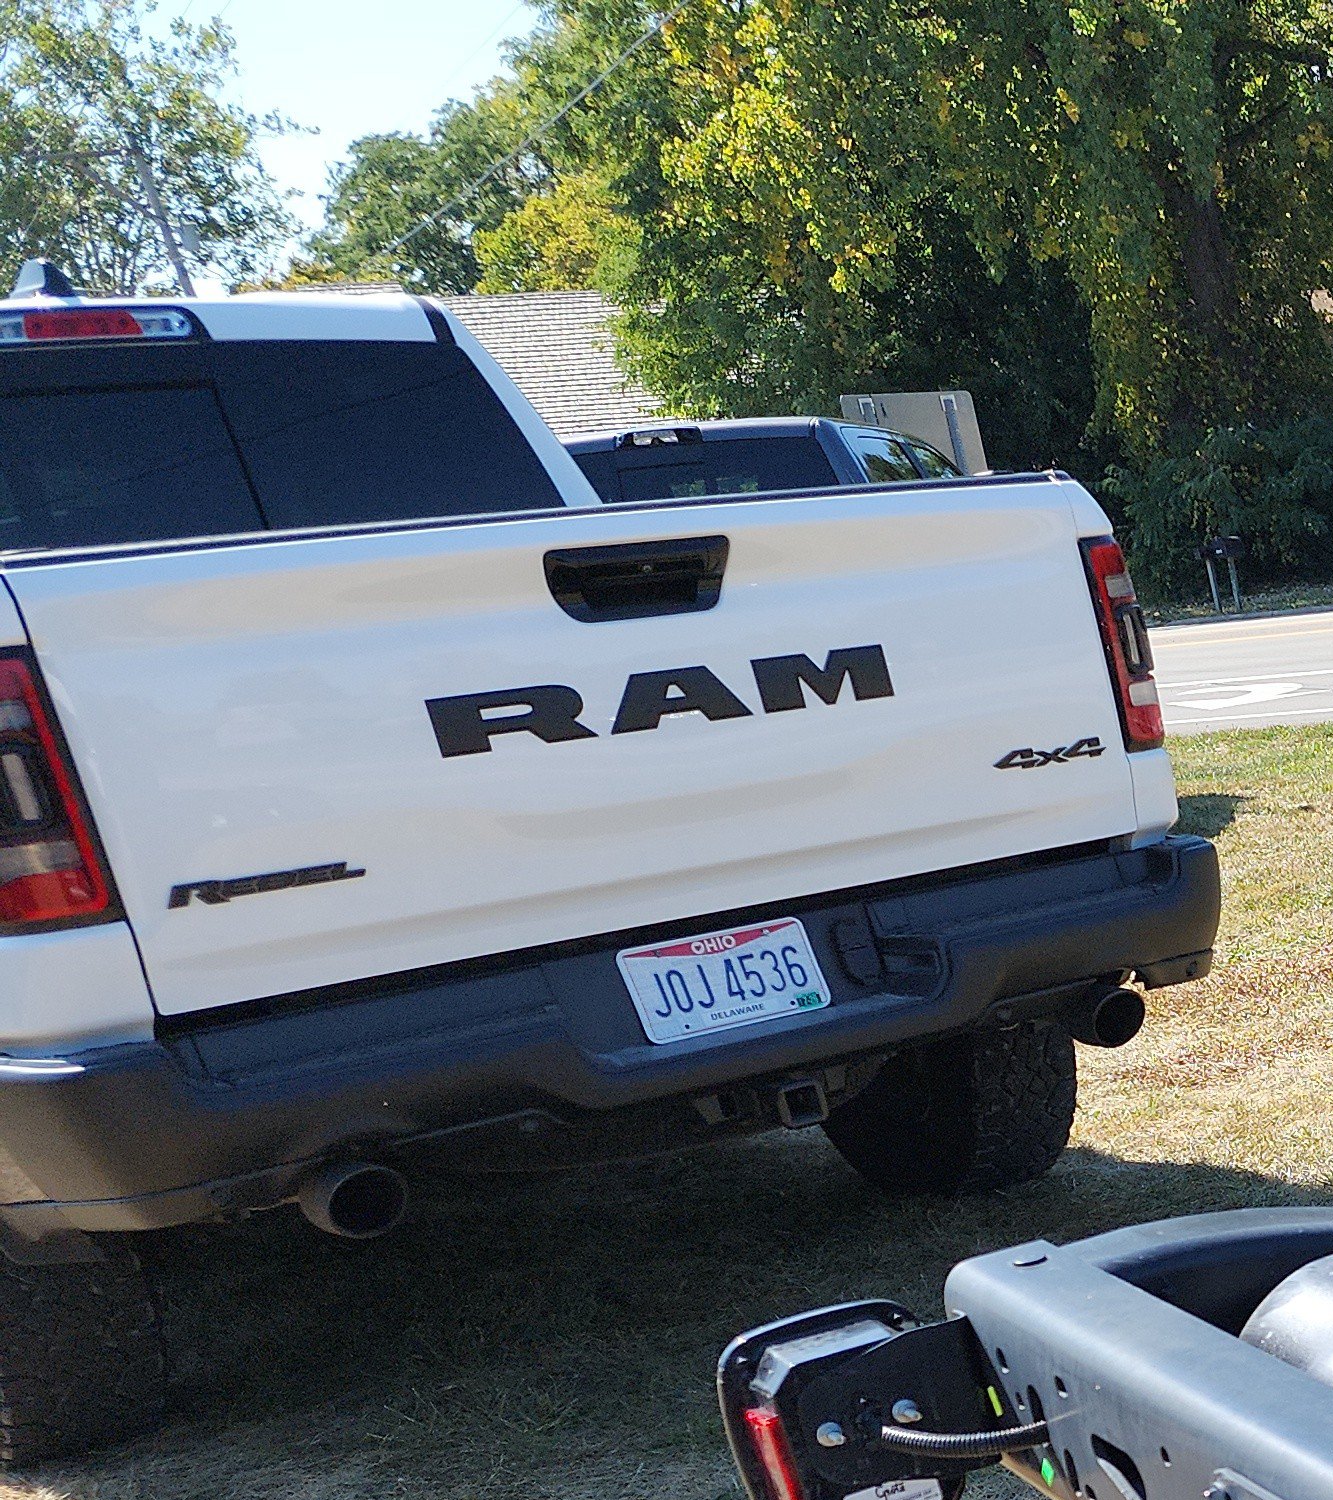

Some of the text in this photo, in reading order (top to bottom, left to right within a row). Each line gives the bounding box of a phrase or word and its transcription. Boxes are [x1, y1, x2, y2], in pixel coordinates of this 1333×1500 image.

[424, 644, 895, 759] RAM
[993, 737, 1106, 769] 4x4
[691, 935, 736, 955] OHIO
[724, 946, 808, 1001] 4536
[711, 1003, 765, 1021] DELAWARE
